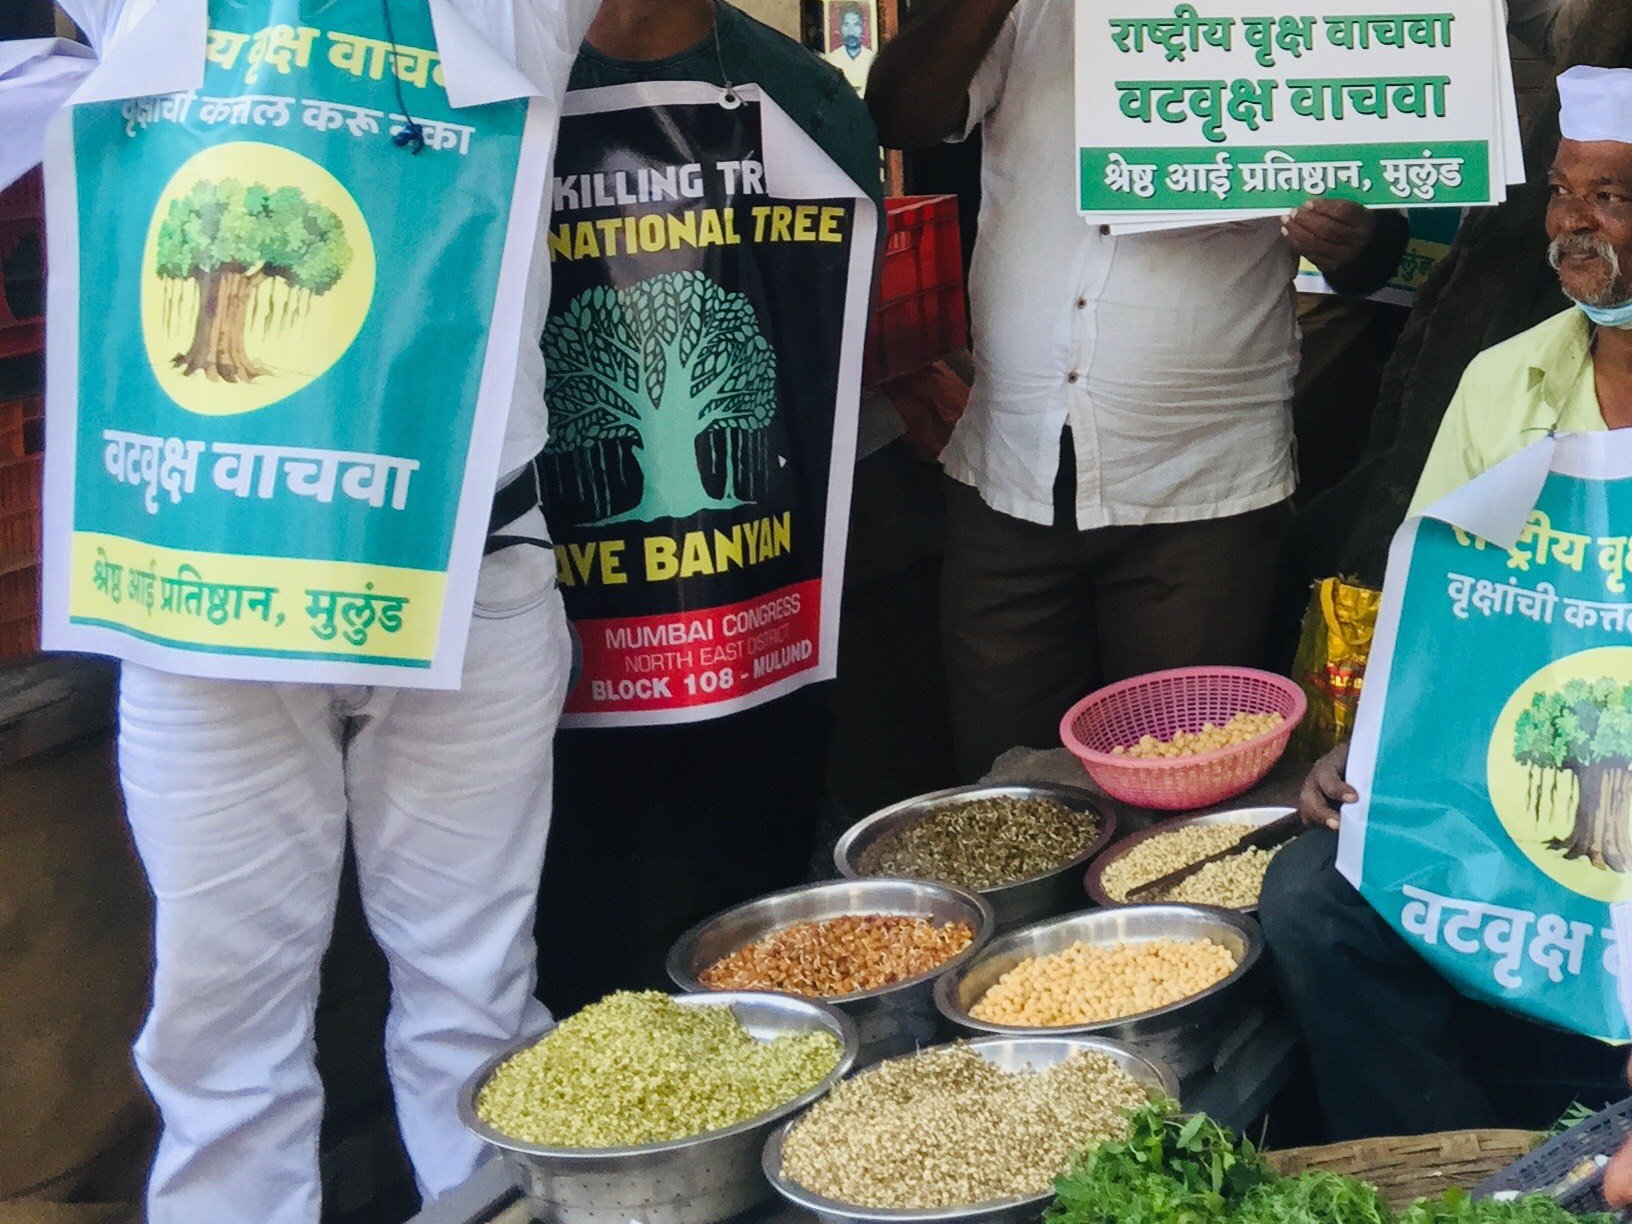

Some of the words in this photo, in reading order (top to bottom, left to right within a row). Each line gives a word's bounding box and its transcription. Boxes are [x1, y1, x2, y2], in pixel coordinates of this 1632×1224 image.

[245, 24, 320, 84] वृक्ष
[327, 31, 449, 88] वाच
[1108, 4, 1235, 61] राष्ट्रीय
[1242, 15, 1316, 67] वृक्ष
[1323, 13, 1455, 51] वाचवा
[201, 94, 296, 127] कत्तल
[302, 99, 384, 136] करू
[1115, 77, 1278, 142] वटवृक्ष
[1286, 75, 1451, 120] वाचवा
[553, 163, 704, 212] KILLING
[1104, 153, 1157, 196] श्रेष्ठ
[1165, 152, 1231, 200] आई
[1239, 150, 1372, 193] प्रतिष्ठान,
[1380, 149, 1463, 201] मुलुंड
[548, 208, 741, 262] NATIONAL
[752, 205, 845, 243] TREE
[102, 428, 205, 515] वटवृक्ष
[211, 442, 419, 512] वाचवा
[554, 540, 628, 588] AVE
[643, 511, 791, 582] BANYAN
[92, 548, 123, 603] श्रेष्ठ
[127, 557, 158, 617] आई
[161, 562, 286, 627] प्रतिष्ठान,
[305, 582, 410, 644] मुलुंड
[605, 619, 713, 649] MUMBAI
[722, 593, 800, 636] CONGRESS
[1447, 572, 1559, 624] वृक्षांची
[591, 676, 672, 701] BLOCK
[684, 667, 734, 695] 108
[753, 639, 813, 678] MULUND
[625, 650, 693, 673] NORTH
[700, 640, 744, 666] EAST
[747, 623, 790, 655] DISTRICT
[1401, 884, 1592, 988] वटवृक्ष
